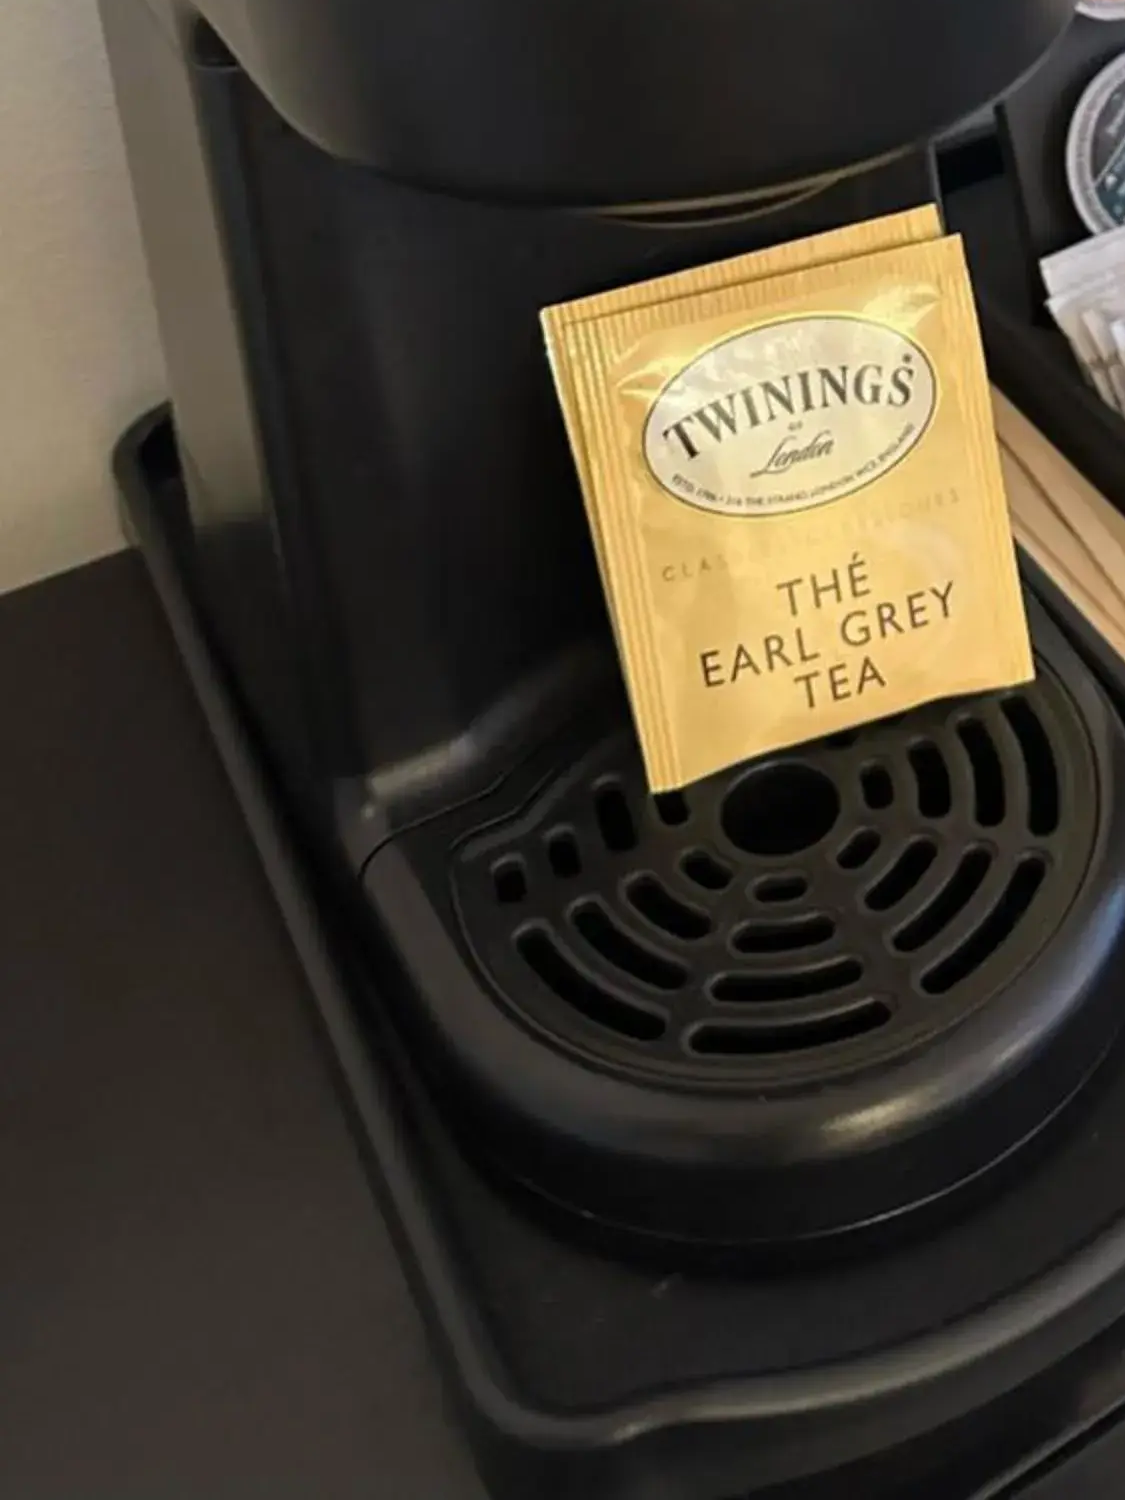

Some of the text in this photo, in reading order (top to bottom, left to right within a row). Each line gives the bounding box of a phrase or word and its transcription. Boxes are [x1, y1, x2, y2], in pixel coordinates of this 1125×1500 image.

[662, 360, 914, 459] TWININGS
[750, 429, 834, 478] London
[776, 552, 871, 618] THÉ
[700, 580, 954, 688] EARL GREY
[793, 656, 886, 710] TEA
